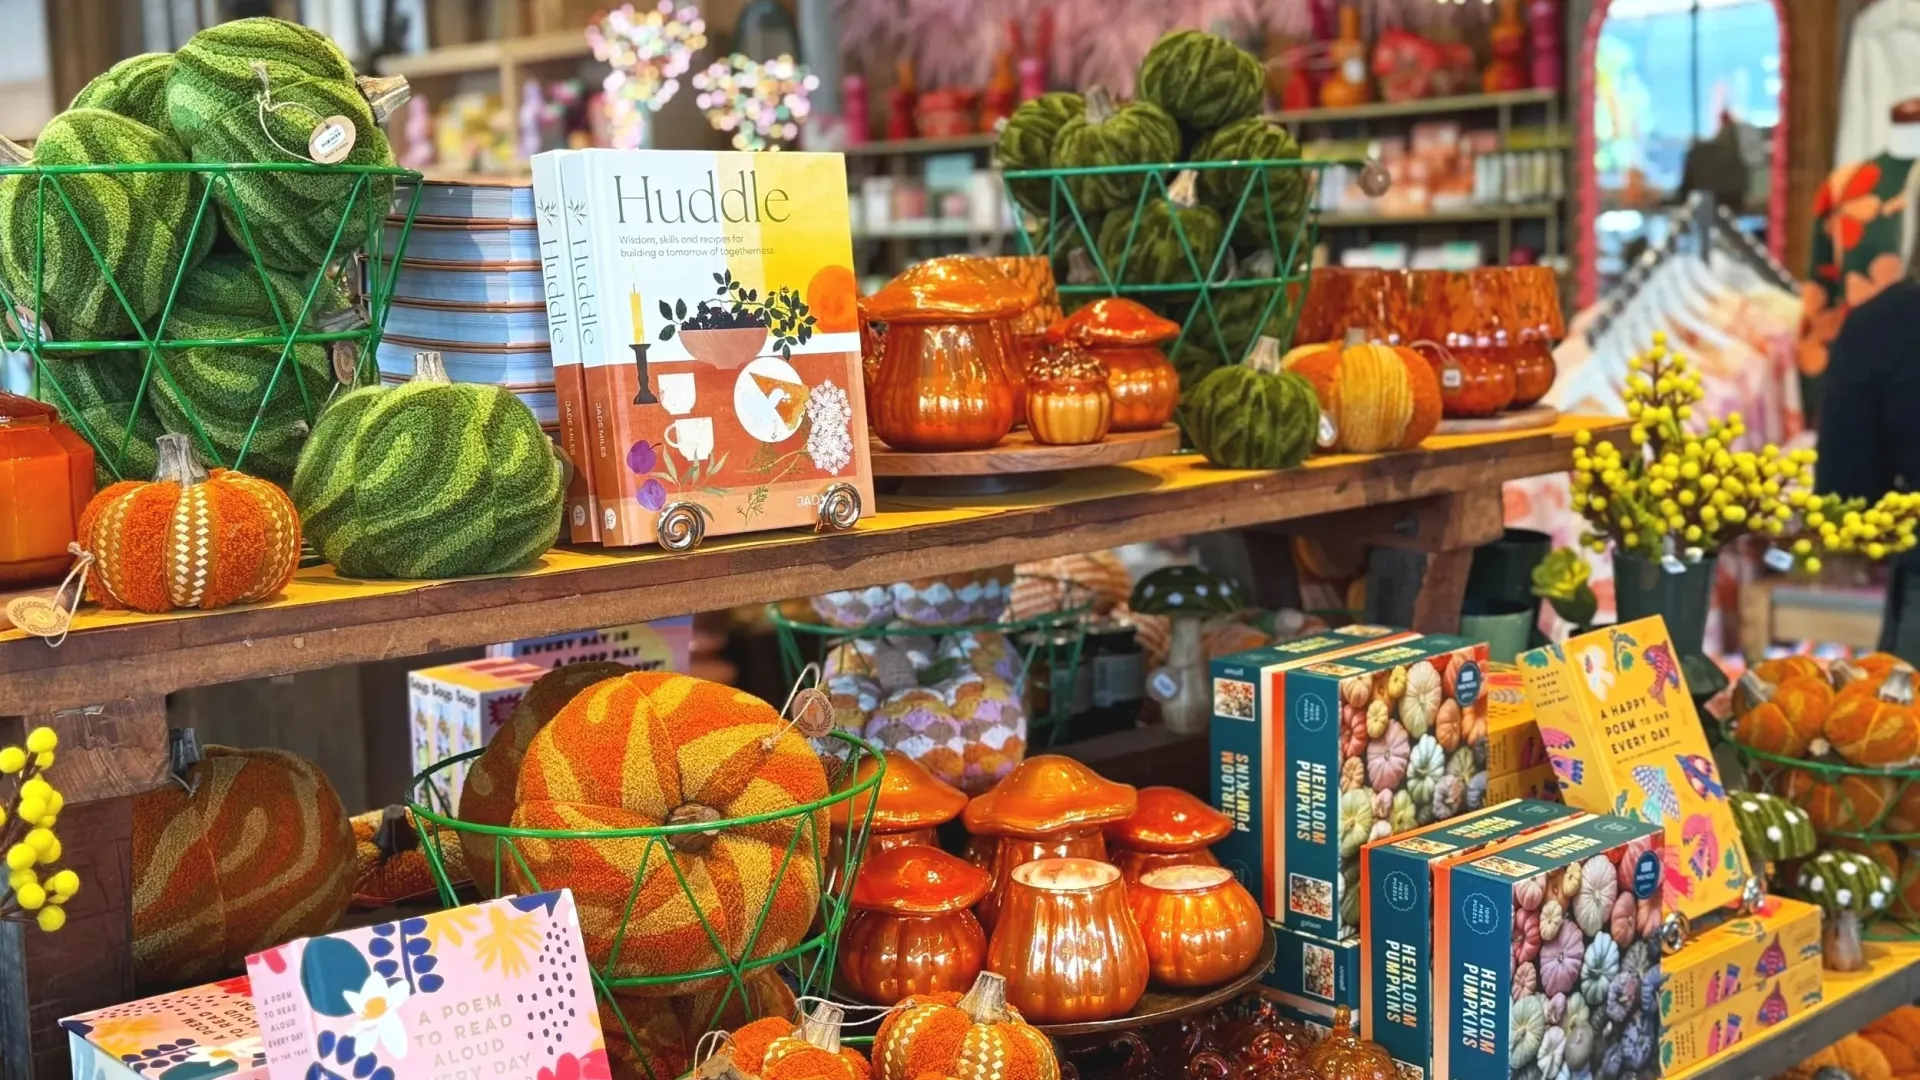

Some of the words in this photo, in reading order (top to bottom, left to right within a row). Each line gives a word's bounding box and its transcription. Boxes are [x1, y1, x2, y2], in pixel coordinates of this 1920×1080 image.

[614, 170, 790, 224] Huddle
[619, 236, 658, 246] Wisdom,
[660, 234, 679, 244] skills
[681, 236, 698, 244] and
[700, 236, 730, 247] recipes
[732, 234, 744, 243] for
[620, 248, 656, 259] building
[710, 247, 718, 256] of
[720, 247, 774, 258] togetherness
[542, 240, 568, 346] Huddle
[572, 240, 598, 346] Huddle
[565, 400, 573, 426] JADE
[598, 430, 607, 458] MILES
[796, 494, 821, 507] JAD
[522, 639, 576, 656] EVERY
[582, 633, 608, 647] DAY
[615, 630, 629, 642] IS
[613, 646, 640, 660] DAY
[432, 682, 454, 704] Soup
[456, 688, 477, 710] Soup
[1600, 710, 1608, 720] A
[1611, 696, 1647, 716] HAPPY
[1605, 719, 1637, 738] POEM
[1640, 716, 1651, 726] TO
[1654, 711, 1670, 722] END
[1611, 733, 1647, 755] EVERY
[1650, 728, 1670, 742] DAY
[1221, 751, 1236, 829] EIRLOOM
[1236, 752, 1250, 832] PUMPKINS
[1296, 760, 1310, 841] PUMPKINS
[1312, 764, 1326, 844] HEIRLOOM
[1386, 939, 1400, 1024] PUMPKINS
[1402, 943, 1417, 1028] HEIRLOOM
[232, 1000, 256, 1011] DAY
[272, 990, 292, 1002] POEM
[1462, 962, 1479, 1049] PUMPKINS
[198, 1012, 234, 1028] READ
[224, 1010, 260, 1028] ALOUD
[264, 1010, 274, 1019] TO
[276, 1004, 297, 1016] READ
[418, 1011, 431, 1026] A
[442, 993, 502, 1020] POEM
[1480, 968, 1497, 1054] HEIRLOOM
[180, 1018, 217, 1036] POEM
[230, 1028, 250, 1038] TO
[270, 1018, 296, 1032] ALOUD
[413, 1030, 442, 1049] TO
[454, 1013, 513, 1040] READ
[268, 1036, 290, 1048] EVERY
[291, 1032, 304, 1042] DAY
[434, 1038, 504, 1068] ALOUD
[494, 1052, 530, 1075] DAY
